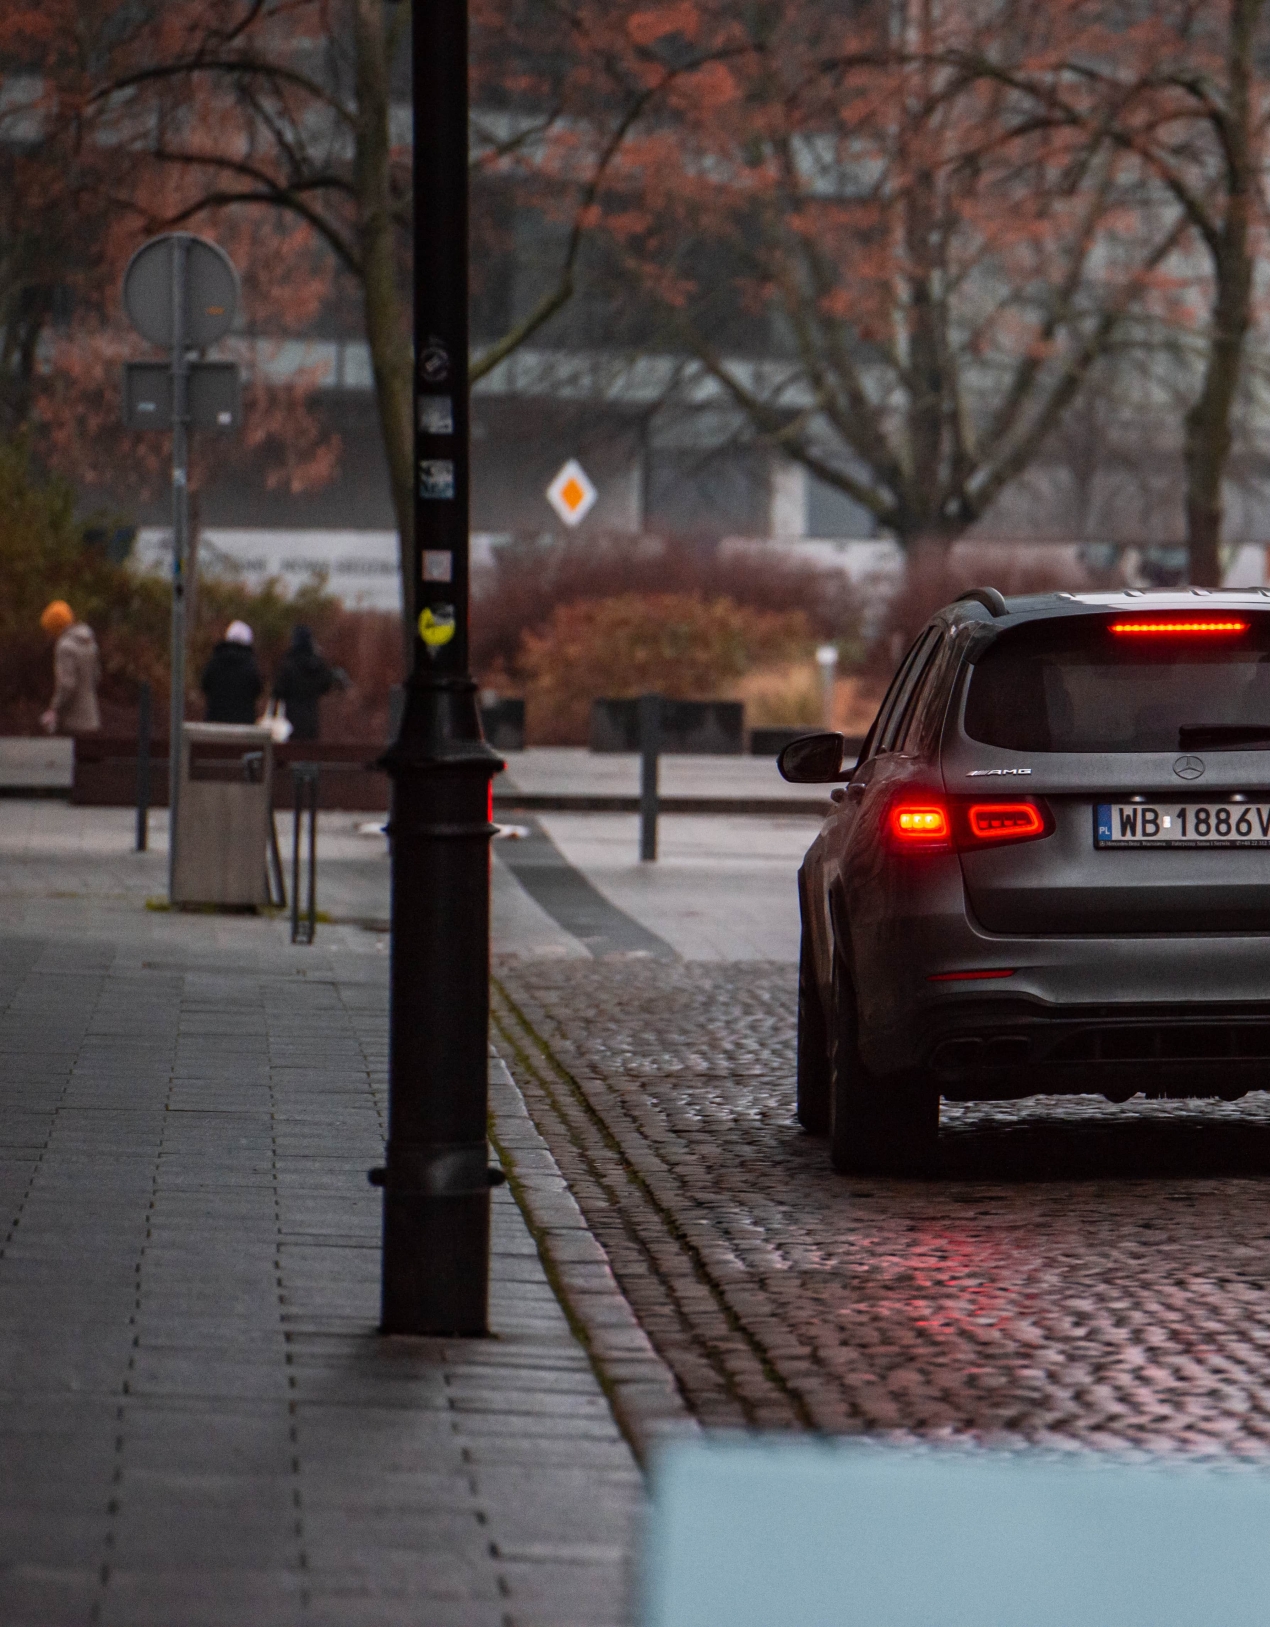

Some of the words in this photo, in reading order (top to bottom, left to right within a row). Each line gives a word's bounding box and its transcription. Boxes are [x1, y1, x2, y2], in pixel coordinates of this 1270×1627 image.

[986, 768, 1032, 776] AMG
[1118, 807, 1161, 838] WB
[1099, 826, 1111, 835] PL
